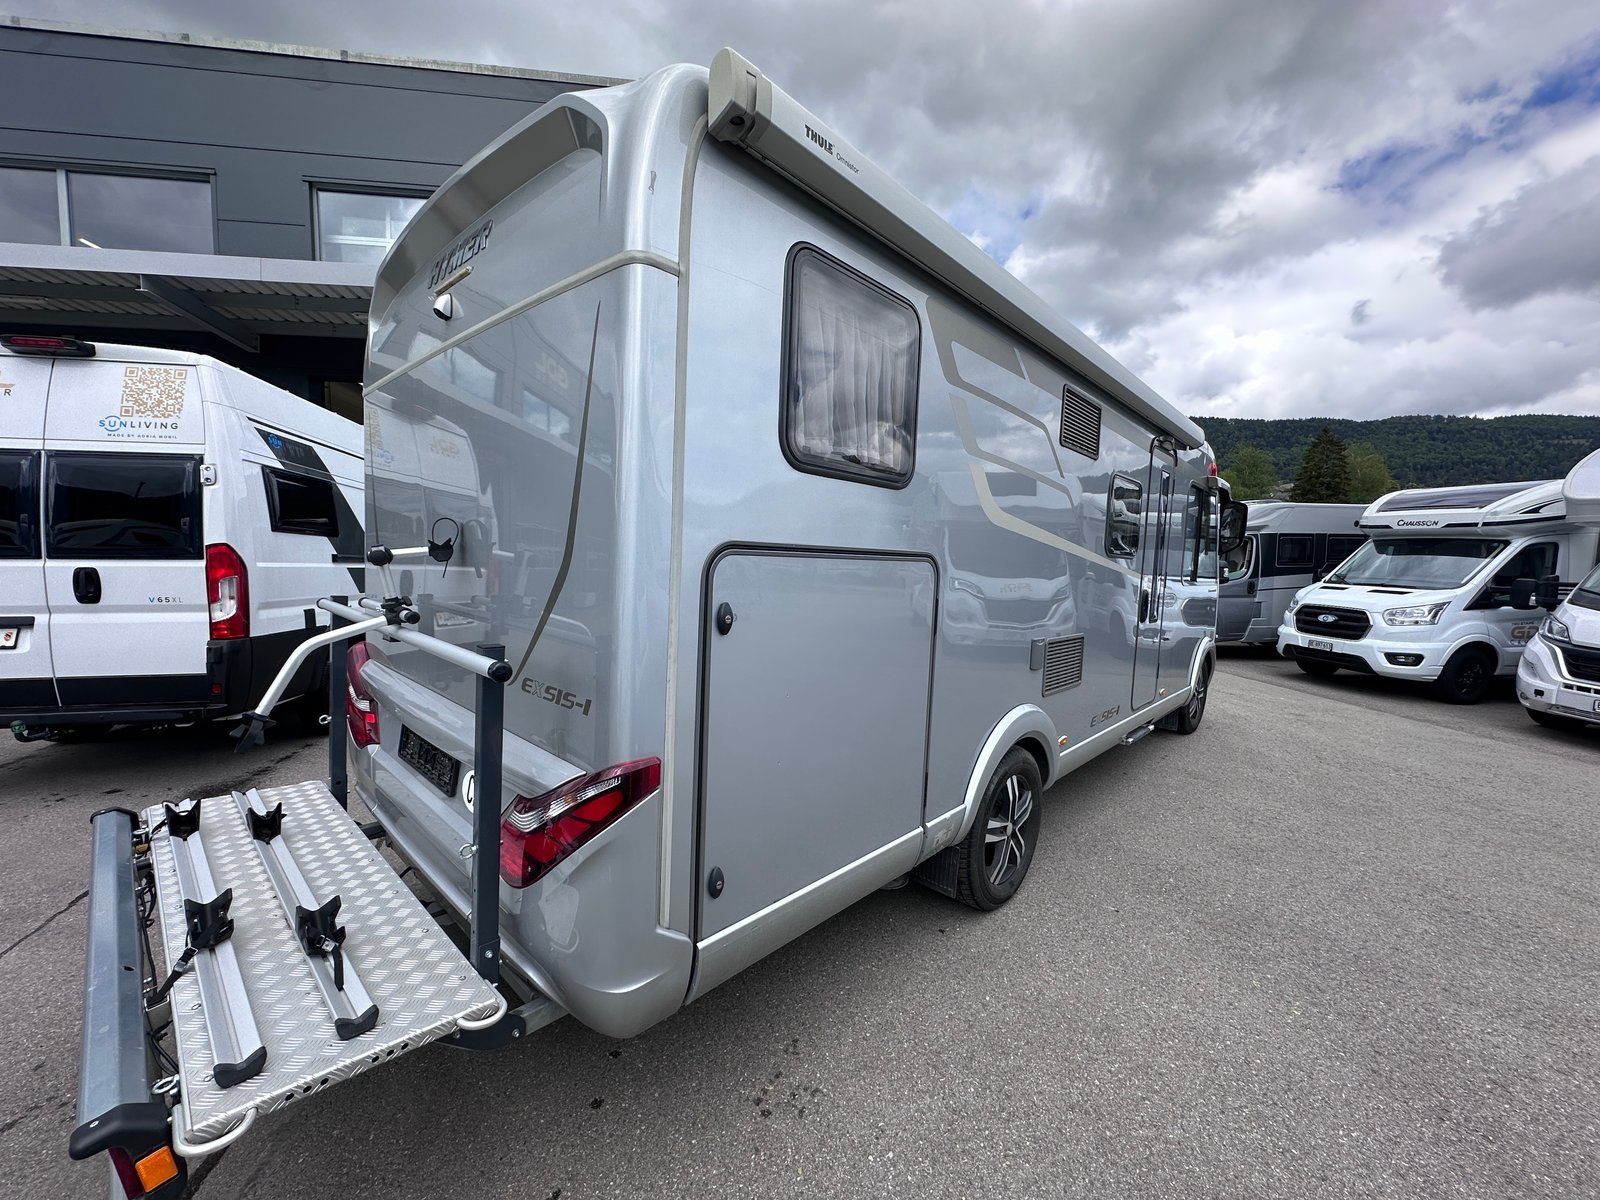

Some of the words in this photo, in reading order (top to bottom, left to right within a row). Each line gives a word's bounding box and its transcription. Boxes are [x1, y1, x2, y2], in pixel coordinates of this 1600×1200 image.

[804, 123, 833, 156] THULE
[836, 152, 860, 174] Omnistor
[428, 219, 494, 290] HYMER
[99, 417, 179, 431] SUNLIVING
[1397, 519, 1439, 527] CHAUSSON
[521, 677, 593, 717] EXSIS-I
